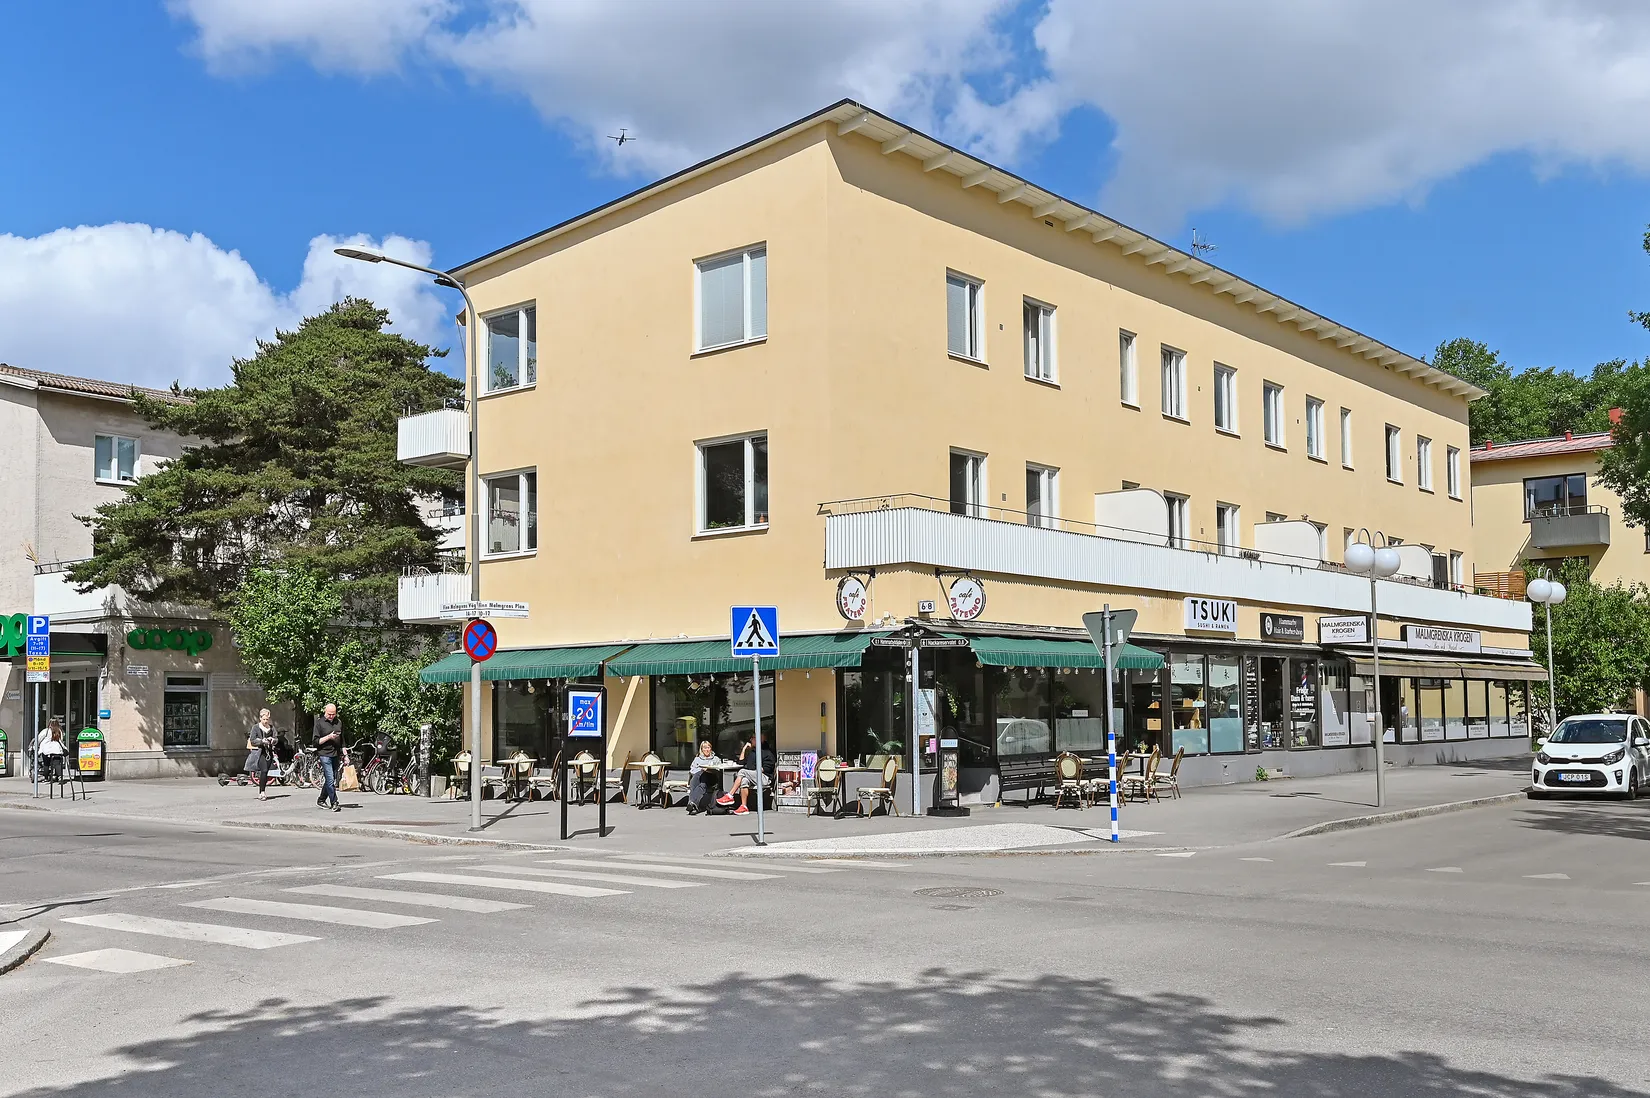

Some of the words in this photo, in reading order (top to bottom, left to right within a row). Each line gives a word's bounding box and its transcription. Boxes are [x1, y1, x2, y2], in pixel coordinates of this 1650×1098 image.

[843, 596, 866, 618] FRATERNO
[950, 597, 981, 618] FRATERNO
[1190, 599, 1235, 622] TSUKI
[33, 618, 46, 633] P
[1321, 620, 1365, 628] MALMGRENSKA
[127, 627, 213, 656] coop
[1415, 627, 1453, 641] MALMGRENSKA
[1453, 631, 1473, 643] KROGEN
[576, 707, 594, 720] 20
